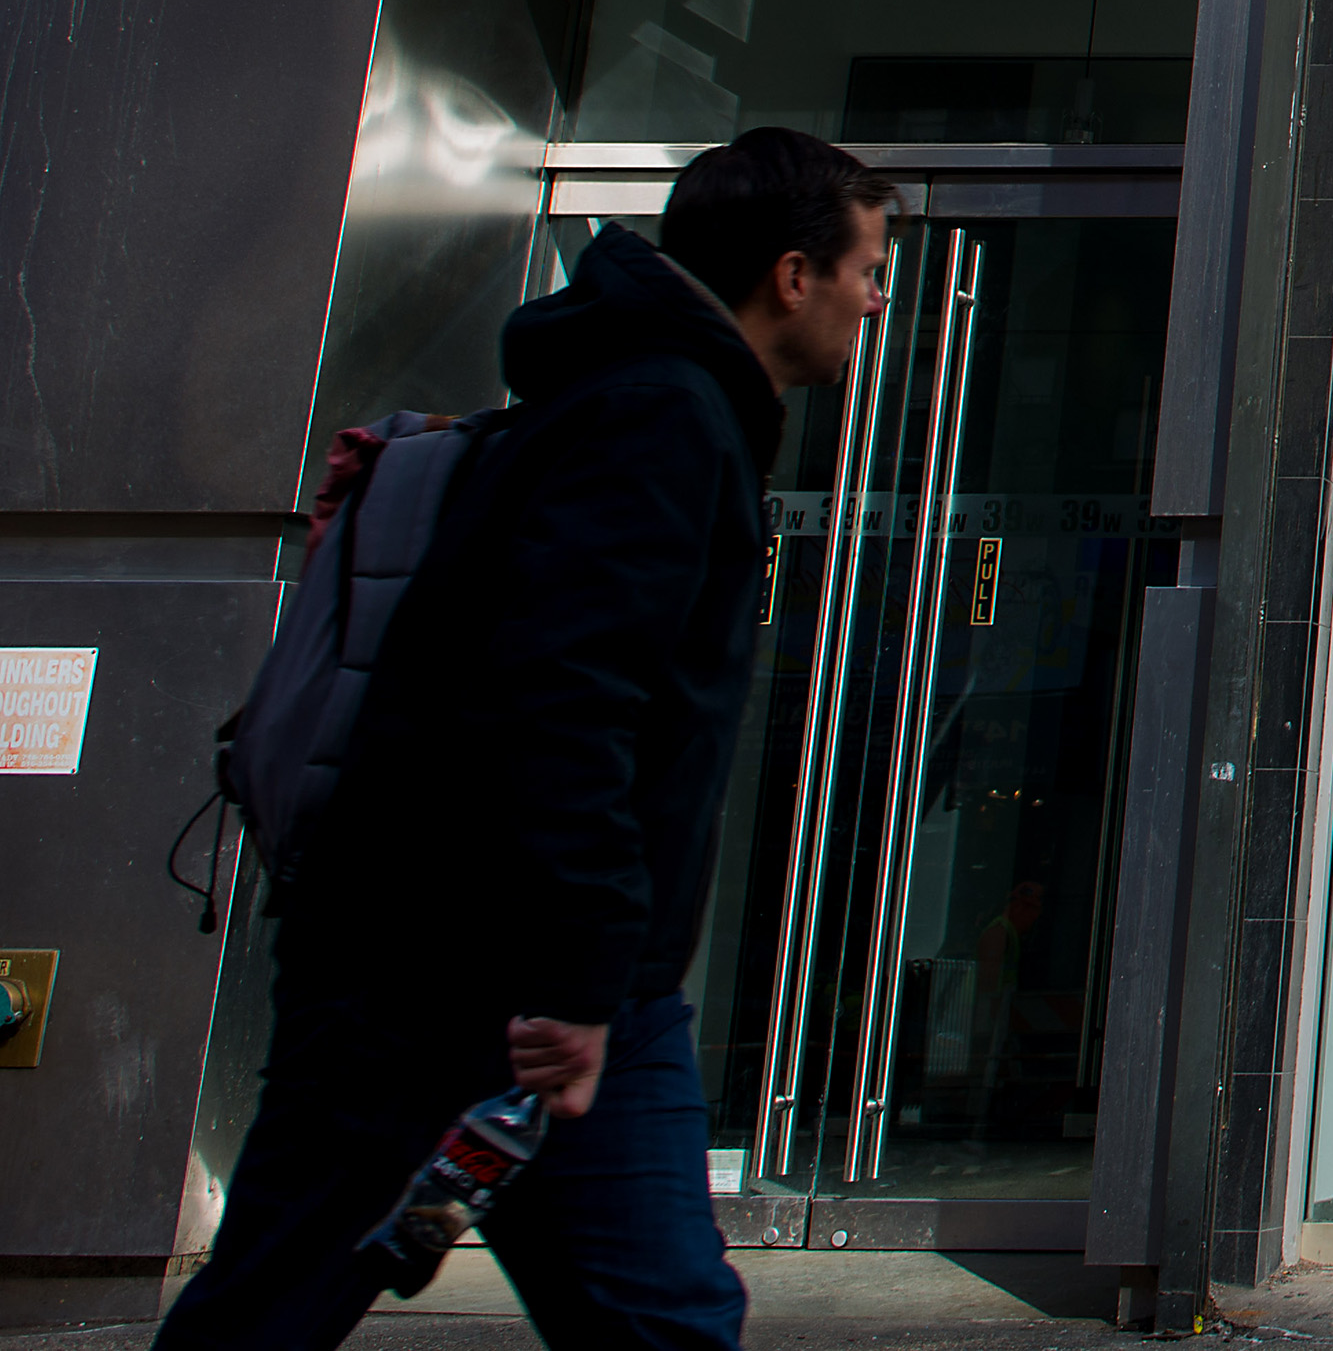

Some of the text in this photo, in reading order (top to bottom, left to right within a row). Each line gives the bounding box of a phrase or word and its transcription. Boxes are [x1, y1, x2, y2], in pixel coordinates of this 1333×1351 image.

[766, 497, 804, 530] 9w
[1060, 499, 1121, 533] 39w
[975, 543, 995, 620] PULL
